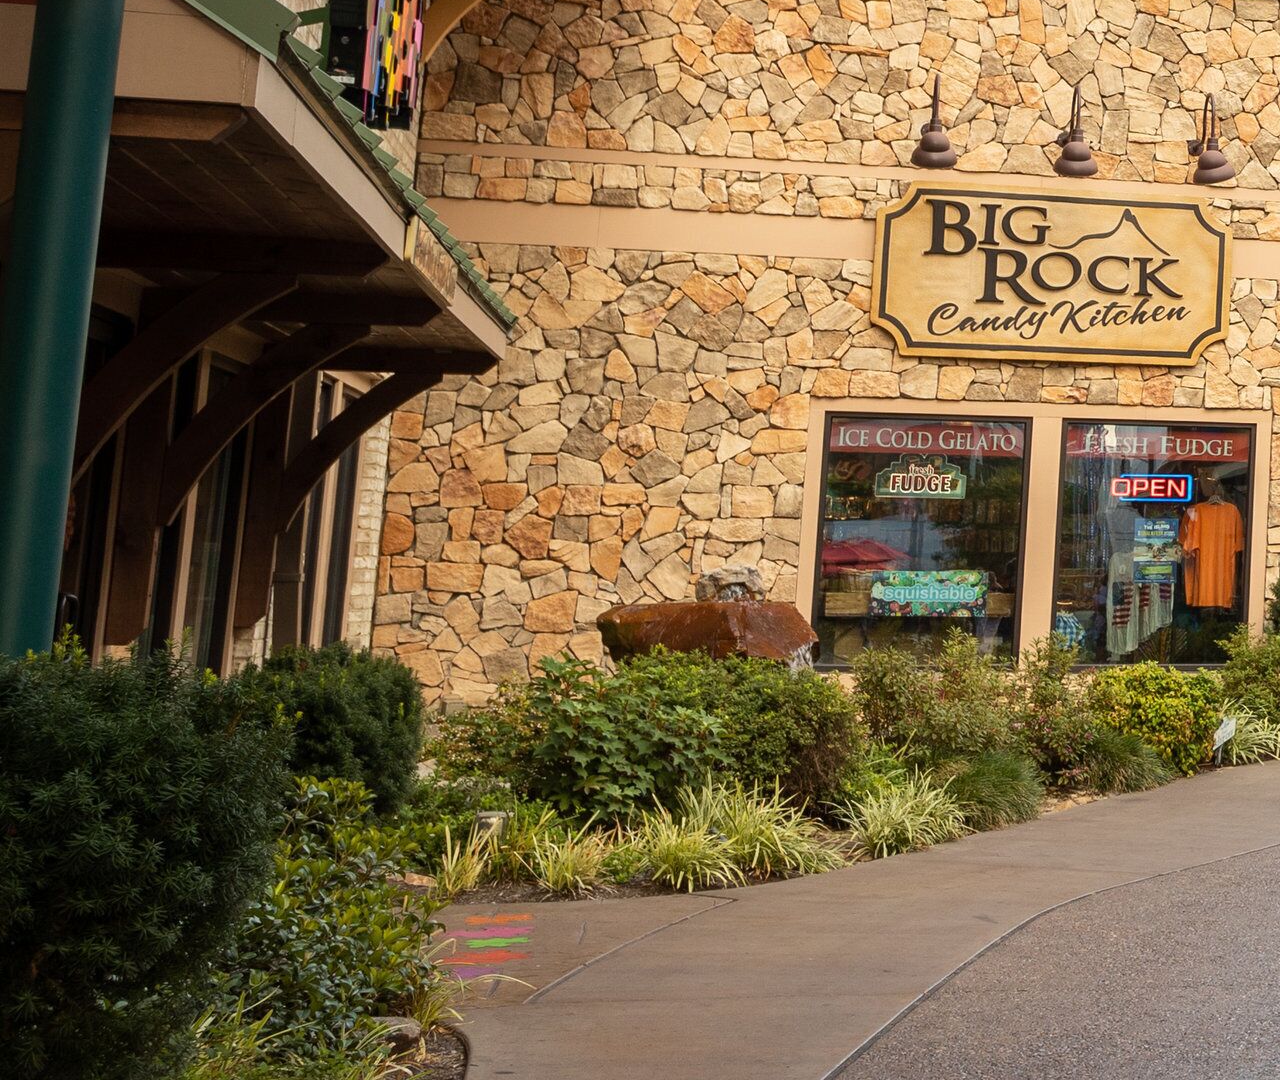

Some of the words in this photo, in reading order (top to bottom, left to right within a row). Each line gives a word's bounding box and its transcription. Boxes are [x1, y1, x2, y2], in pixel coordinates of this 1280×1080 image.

[922, 198, 1051, 256] BIG
[974, 246, 1184, 305] ROCK
[927, 302, 1050, 340] Candy
[1050, 298, 1191, 335] Kitchen
[838, 426, 869, 448] ICE
[876, 427, 932, 449] COLD
[938, 429, 1017, 452] GELATO
[1084, 433, 1148, 455] FRESH
[1160, 435, 1234, 457] FUDGE
[908, 463, 935, 476] fresh
[889, 473, 952, 494] FUDGE
[1111, 477, 1187, 498] OPEN
[883, 584, 977, 603] squishable
